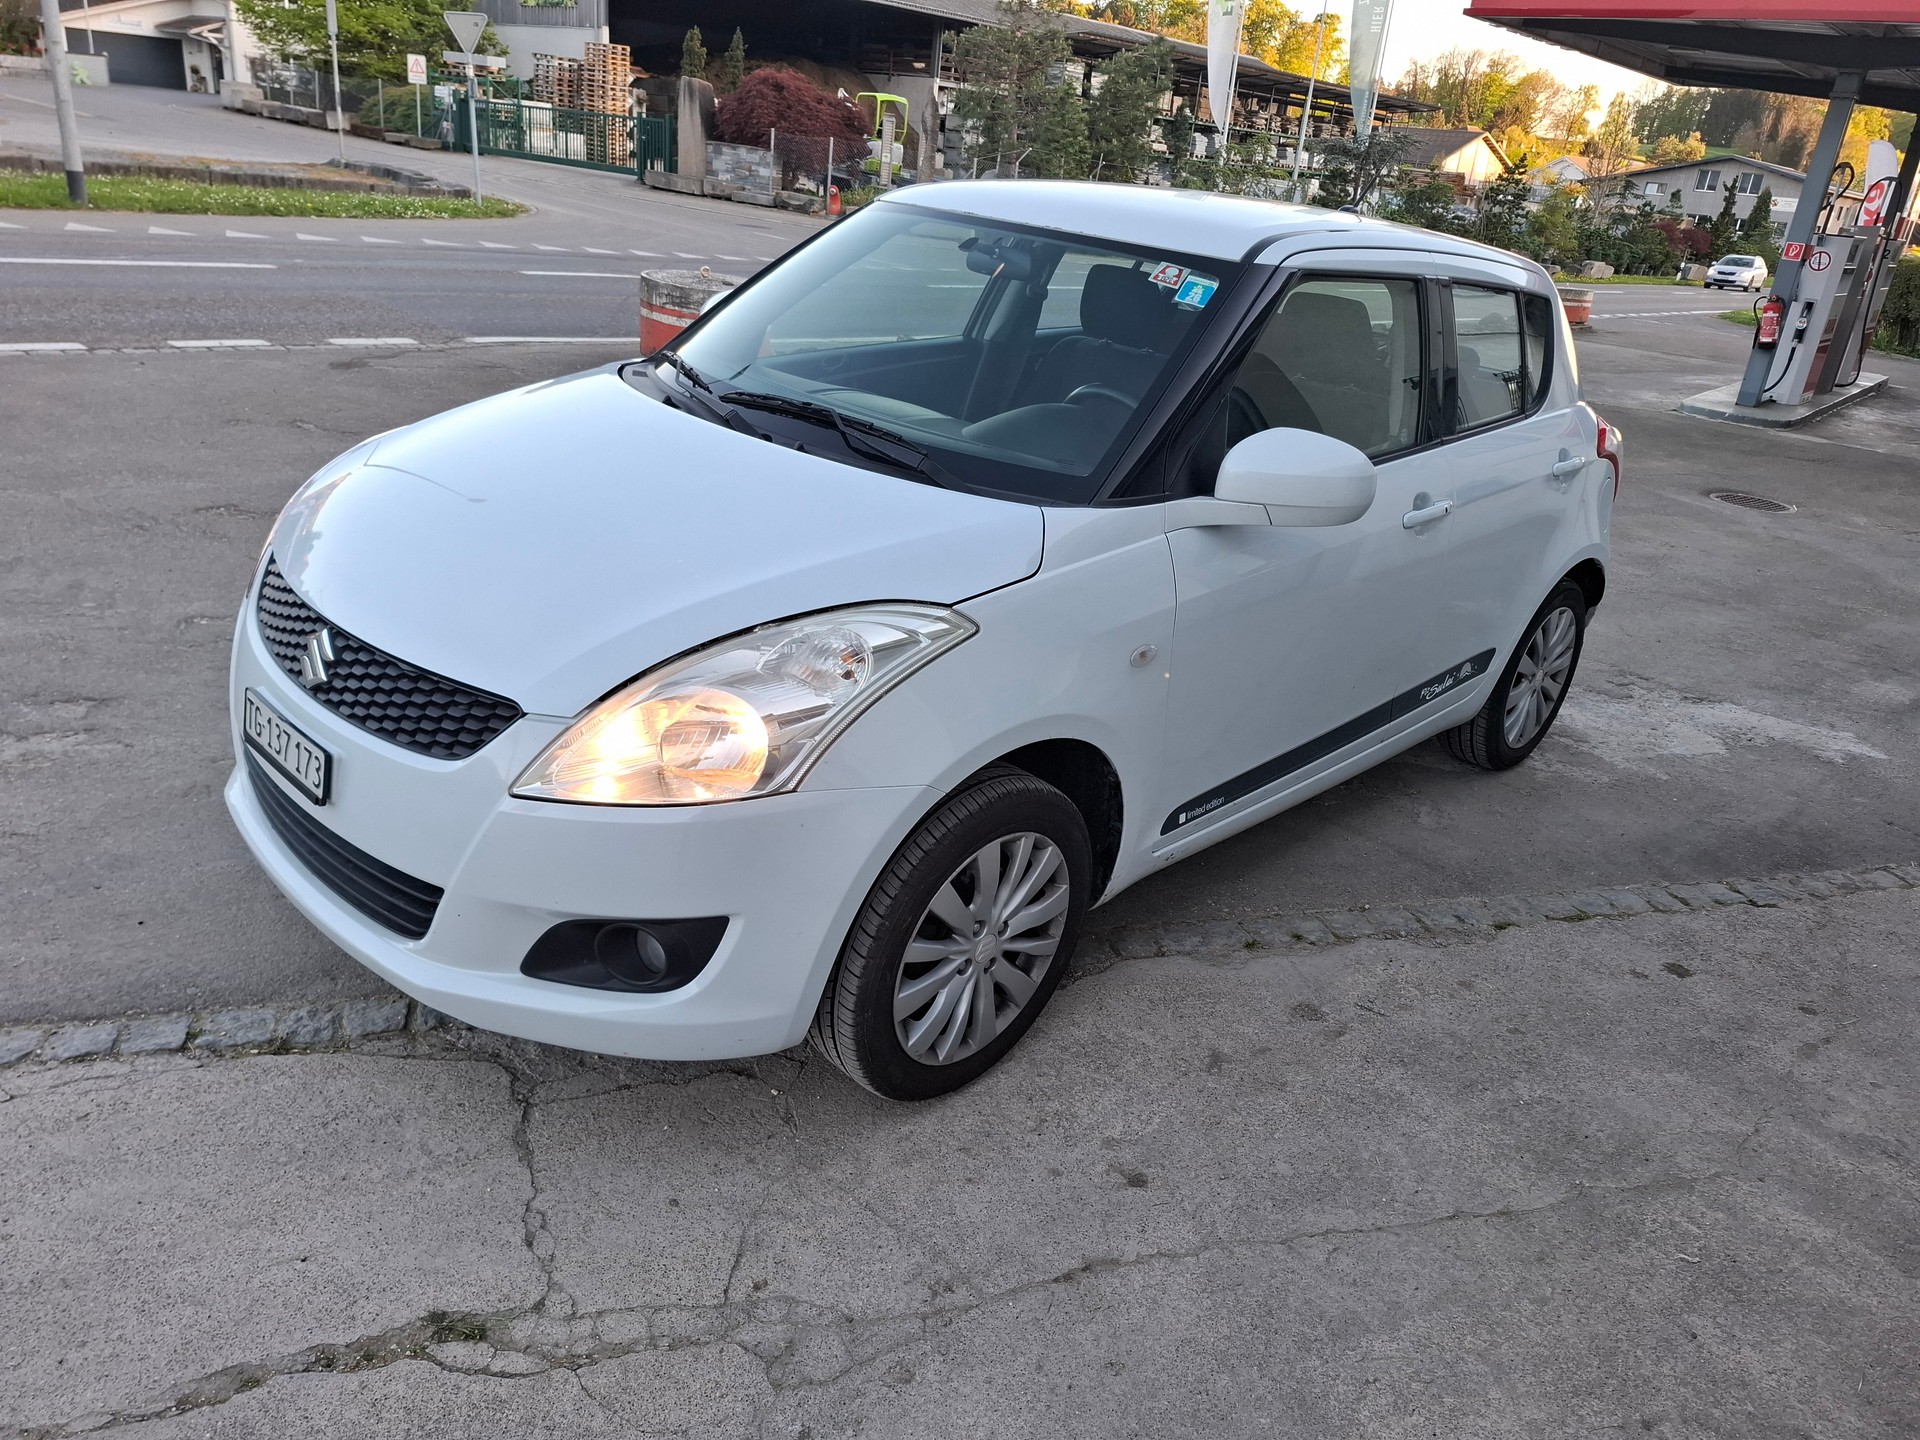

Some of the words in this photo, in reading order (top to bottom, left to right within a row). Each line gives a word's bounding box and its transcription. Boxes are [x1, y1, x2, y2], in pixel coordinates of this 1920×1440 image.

[295, 741, 322, 790] 173
[1187, 803, 1206, 819] limited
[1206, 796, 1225, 811] edition
